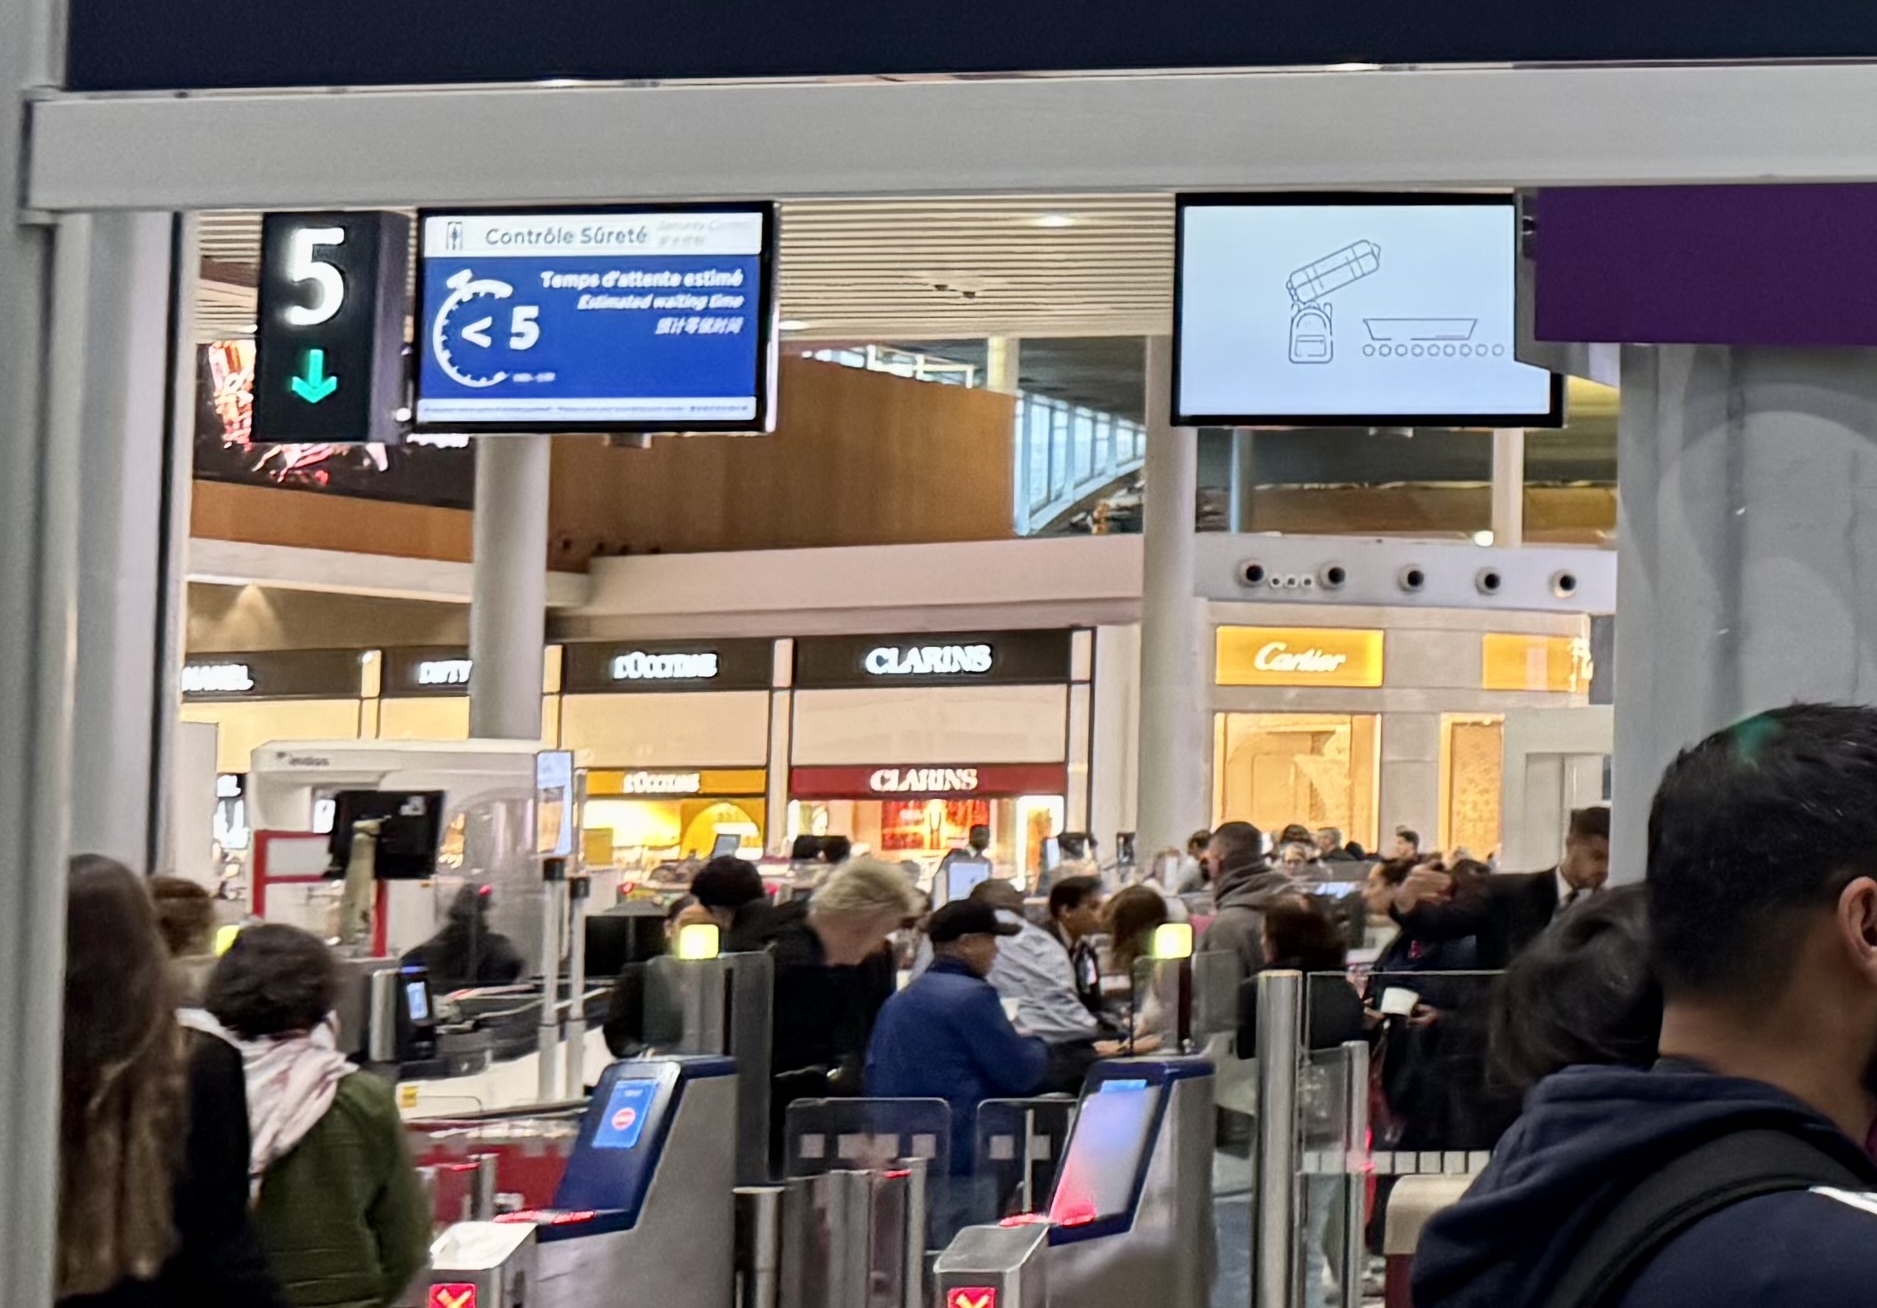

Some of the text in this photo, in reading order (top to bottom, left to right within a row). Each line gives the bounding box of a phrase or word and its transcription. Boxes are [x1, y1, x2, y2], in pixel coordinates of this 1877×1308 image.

[485, 225, 575, 246] Contrôle
[580, 225, 648, 245] Sûreté
[288, 227, 345, 326] 5
[540, 268, 744, 289] Temps d'attente estimé
[577, 294, 652, 311] Estimated
[653, 294, 707, 312] waiting
[509, 305, 541, 350] 5
[865, 644, 993, 675] CLARINS
[1253, 641, 1347, 672] Cartier
[869, 768, 979, 792] CLARINS
